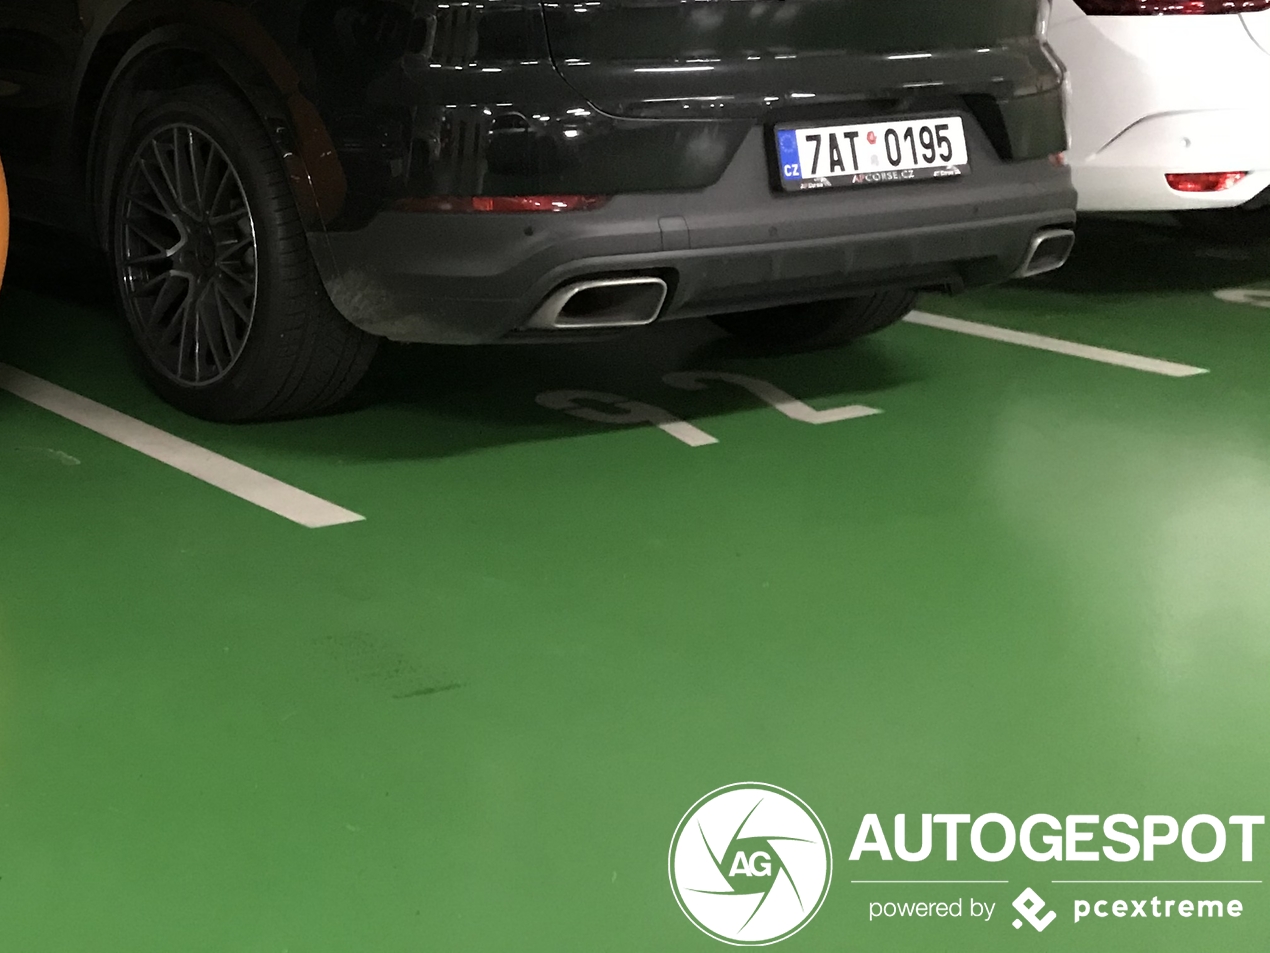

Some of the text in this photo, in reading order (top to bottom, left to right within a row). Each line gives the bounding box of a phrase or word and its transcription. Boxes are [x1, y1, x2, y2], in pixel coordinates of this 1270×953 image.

[805, 124, 954, 175] 7AT 0195
[783, 163, 800, 178] CZ
